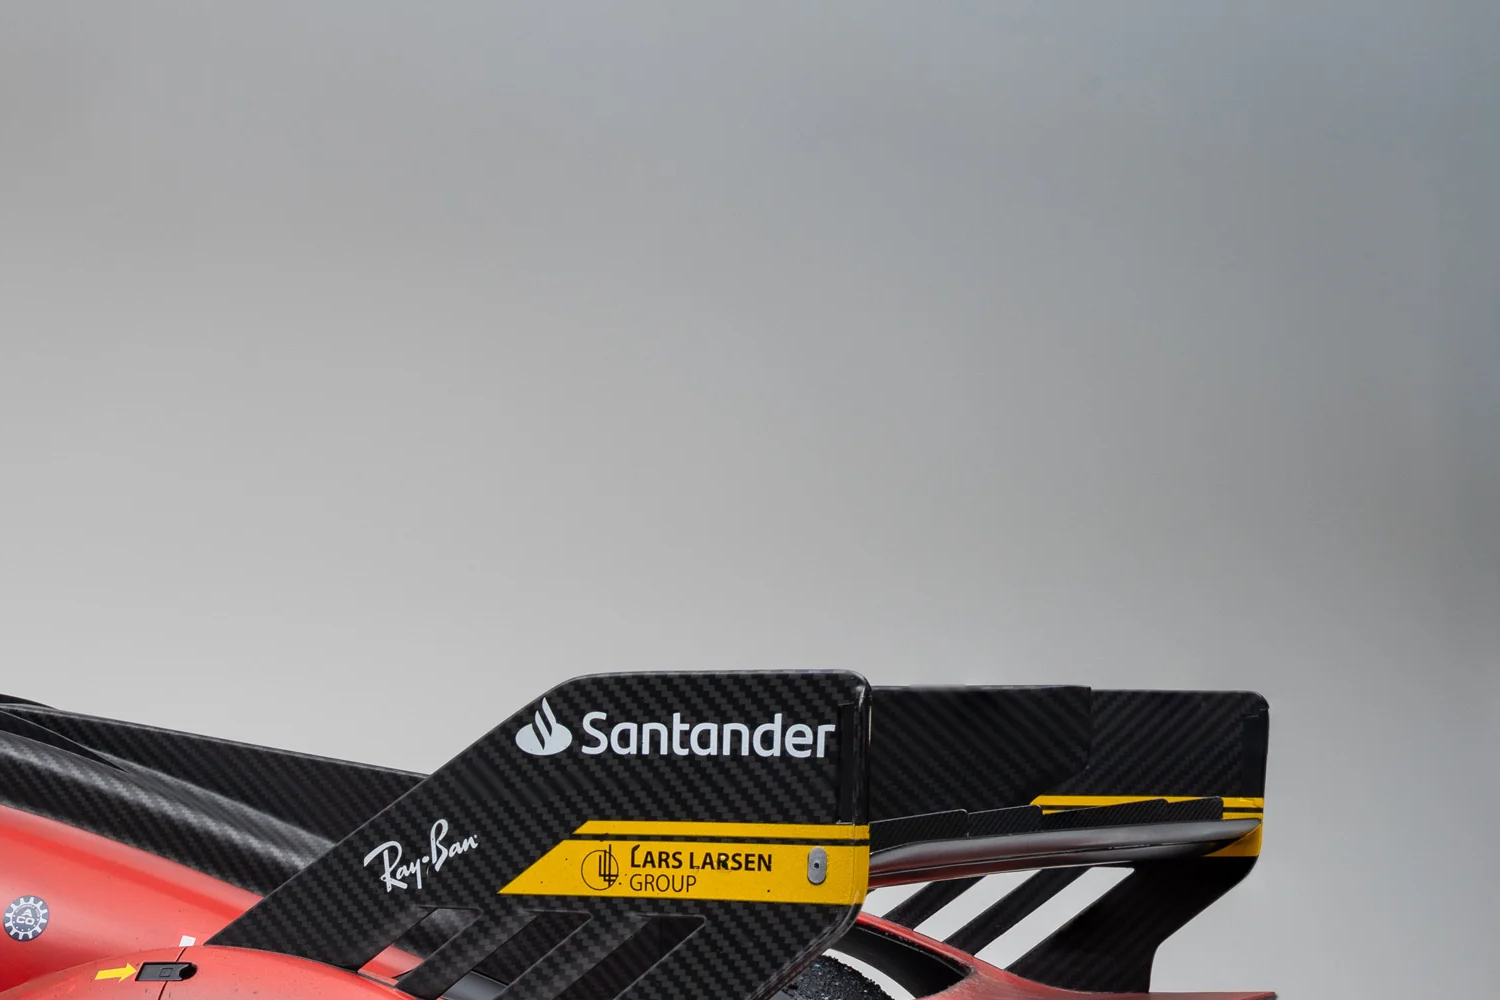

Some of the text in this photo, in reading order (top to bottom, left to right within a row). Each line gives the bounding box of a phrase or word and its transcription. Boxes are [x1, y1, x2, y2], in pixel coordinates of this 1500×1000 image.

[581, 711, 836, 758] Santander
[630, 844, 772, 872] LARS LARSEN
[629, 873, 697, 894] GROUP
